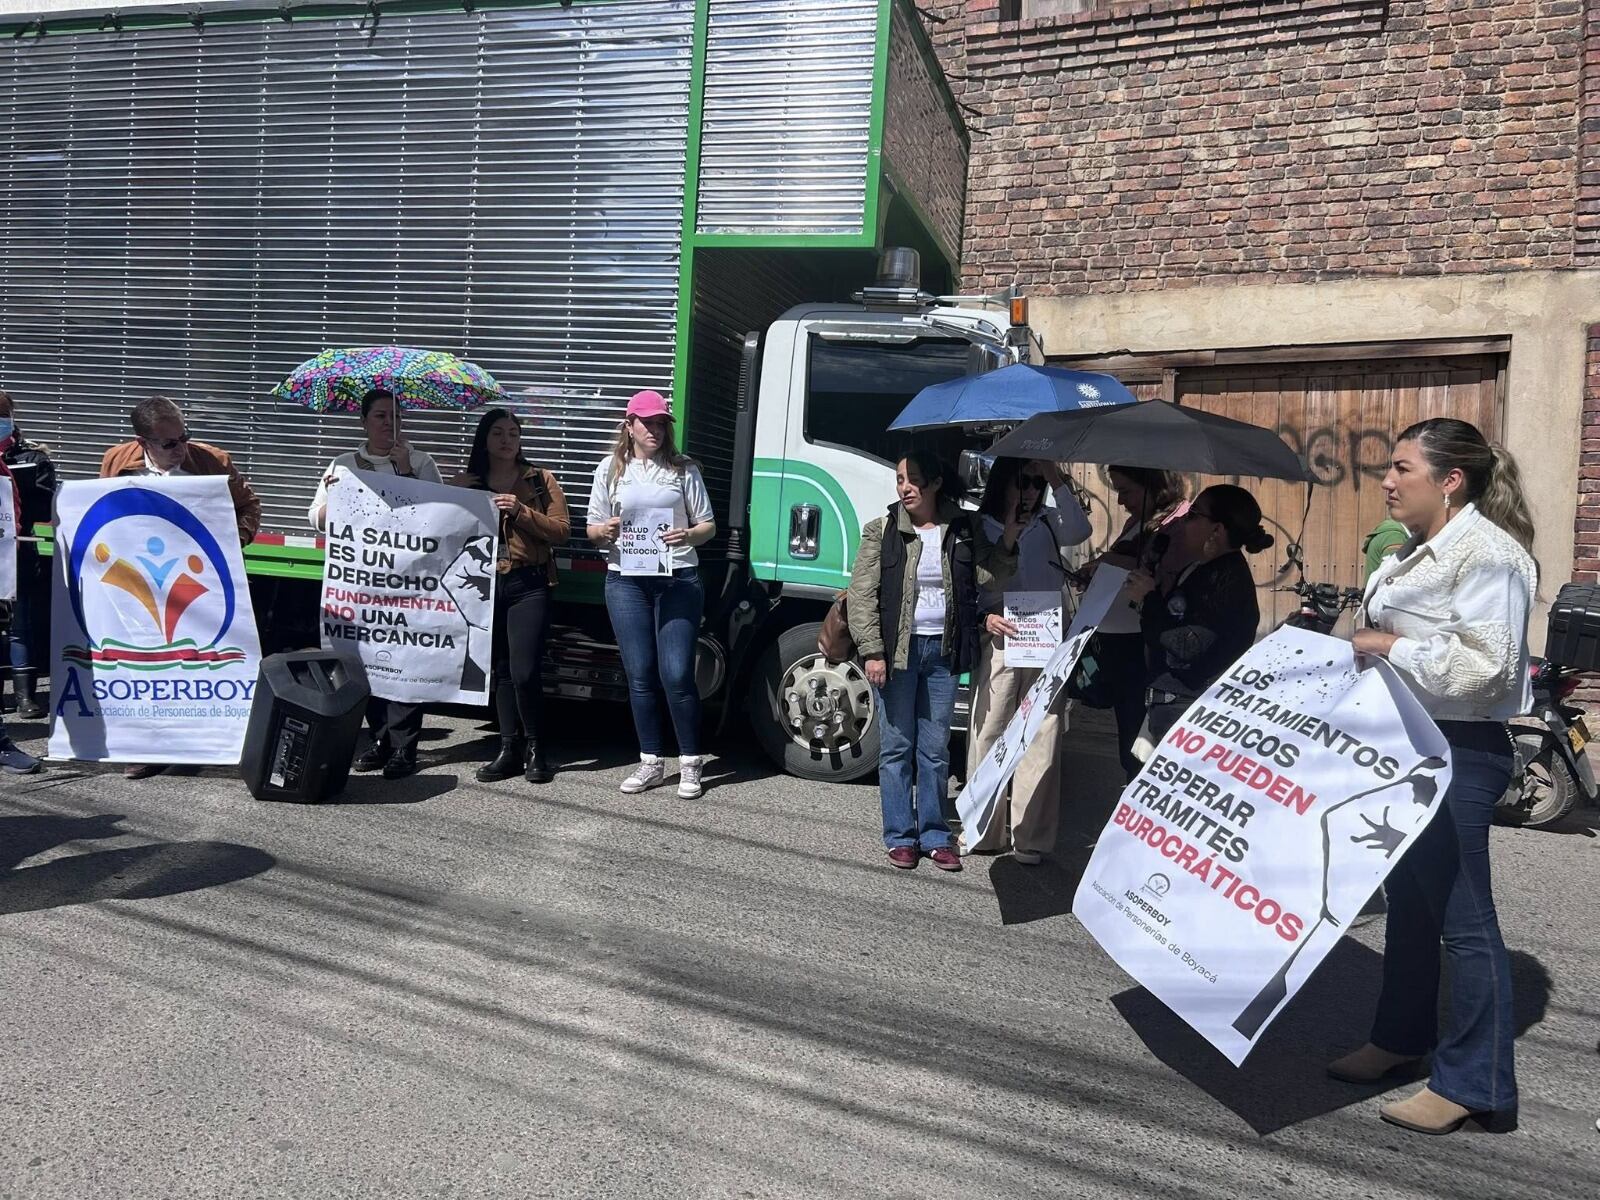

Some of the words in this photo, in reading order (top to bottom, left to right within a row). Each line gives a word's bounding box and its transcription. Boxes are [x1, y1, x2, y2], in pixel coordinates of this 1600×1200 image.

[329, 522, 355, 542] LA
[362, 527, 439, 554] SALUD
[329, 542, 356, 563] ES
[362, 549, 395, 569] UN
[327, 563, 439, 592] DERECHO
[324, 603, 355, 622] NO
[362, 609, 409, 627] UNA
[325, 586, 456, 613] FUNDAMENTAL
[1229, 664, 1275, 691] LOS
[138, 705, 150, 717] de
[210, 705, 222, 717] de
[1187, 706, 1301, 768] MÉDICOS
[1214, 683, 1400, 780] TRATAMIENTOS
[1167, 726, 1206, 754] NO
[1201, 743, 1317, 816] PUEDEN
[1147, 754, 1256, 828] ESPERAR
[1130, 779, 1249, 863] TRÁMITES
[1113, 803, 1304, 942] BUROCRÁTICOS
[1124, 889, 1171, 927] ASOPERBOY
[1124, 905, 1168, 945] Personerías
[1167, 943, 1181, 955] de
[1181, 951, 1218, 984] Boyacá
